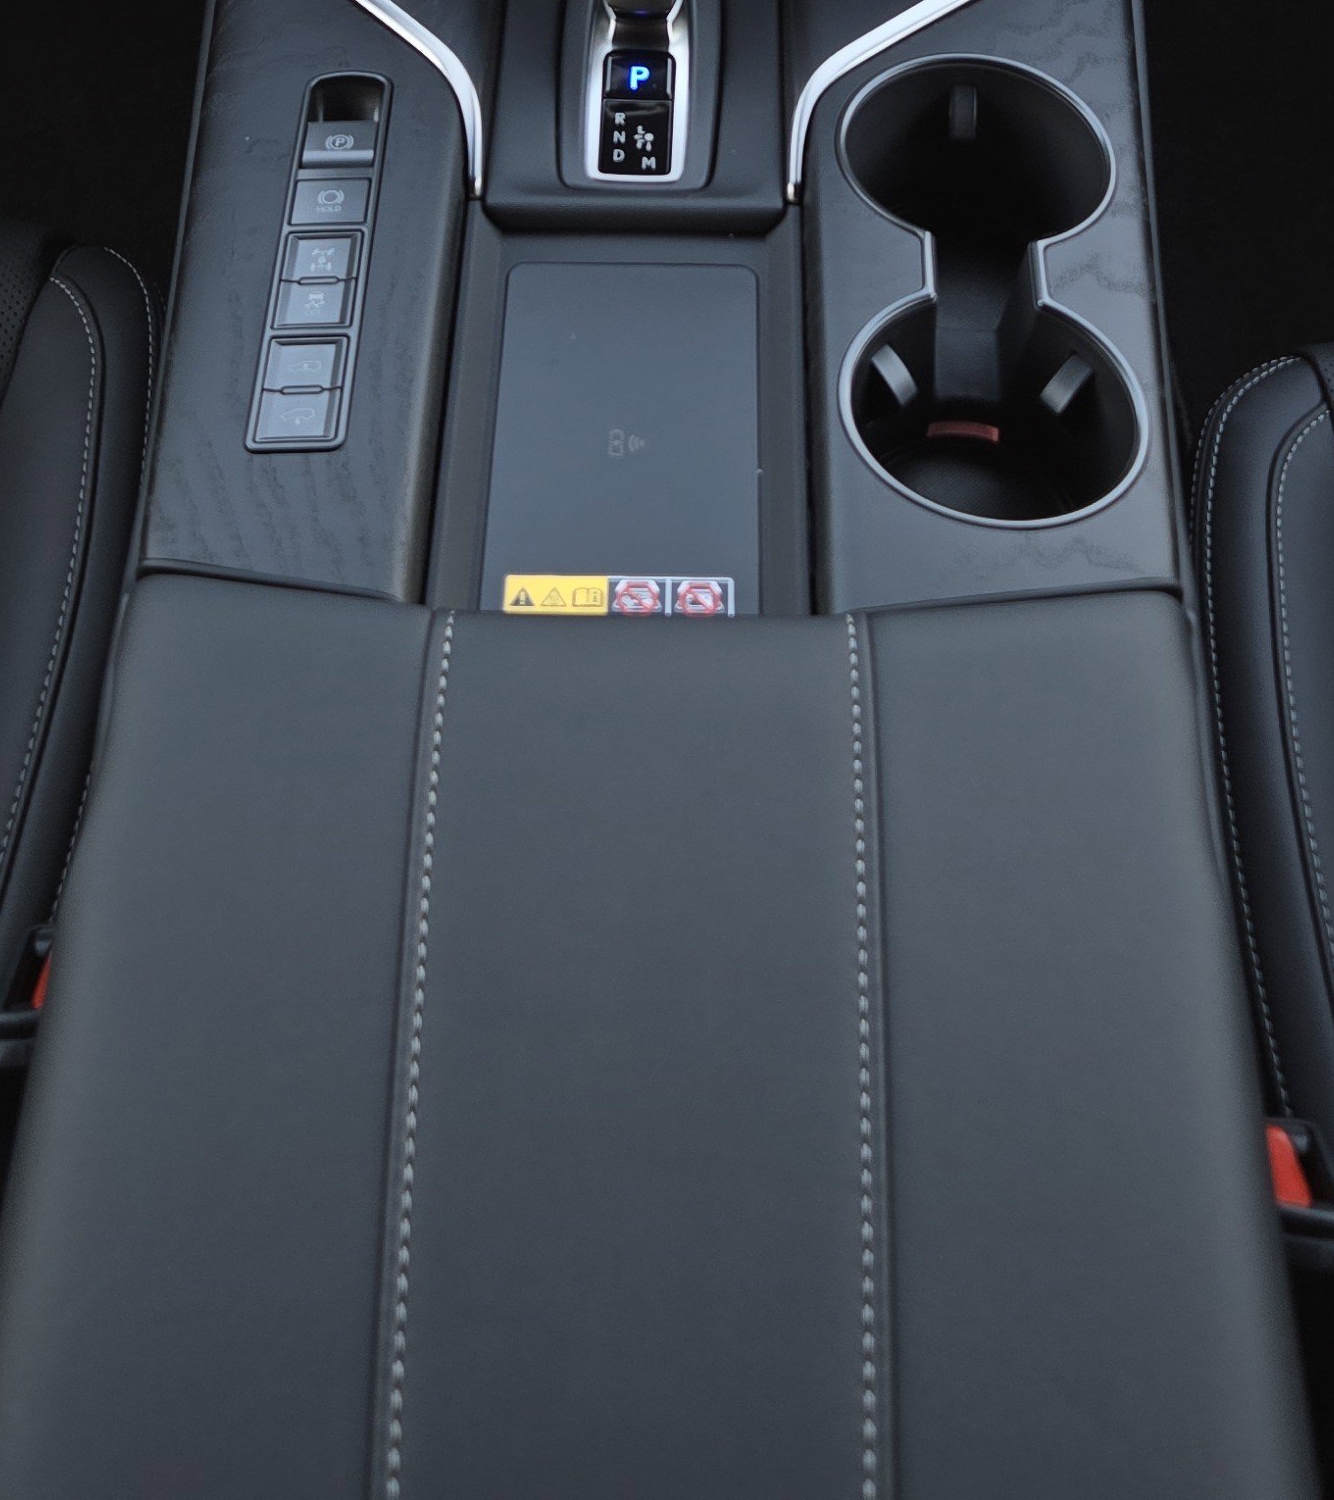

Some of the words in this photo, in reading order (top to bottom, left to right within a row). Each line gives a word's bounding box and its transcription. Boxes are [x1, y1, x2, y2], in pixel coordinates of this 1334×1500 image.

[629, 65, 650, 91] P
[614, 112, 626, 125] R
[612, 130, 626, 145] N
[612, 148, 626, 163] D
[641, 156, 657, 171] M
